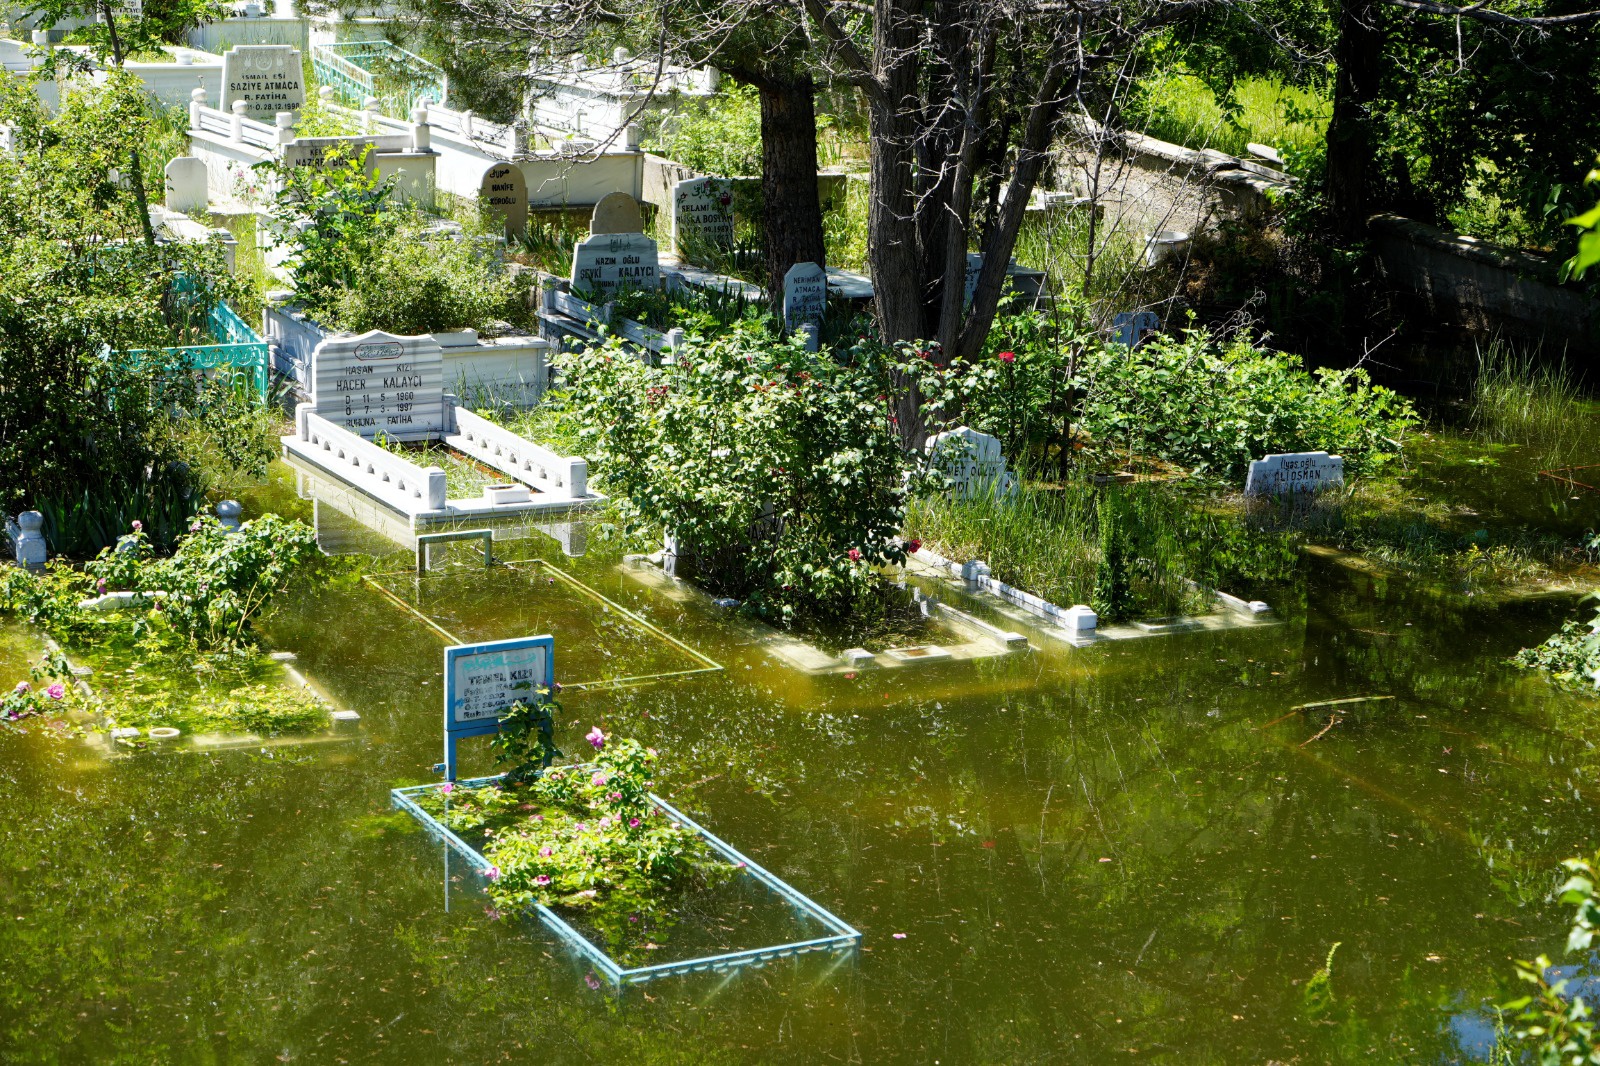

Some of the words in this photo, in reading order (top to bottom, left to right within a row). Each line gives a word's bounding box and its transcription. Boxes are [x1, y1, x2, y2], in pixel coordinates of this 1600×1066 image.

[264, 80, 299, 91] ATMACA
[255, 91, 287, 100] FATİHA
[622, 254, 641, 265] OĞLU
[618, 266, 655, 278] KALAYCI
[345, 365, 373, 375] HASAN
[336, 379, 366, 392] HACER
[396, 391, 414, 401] 1960
[396, 402, 413, 412] 1997
[387, 414, 413, 425] FATİHA
[510, 668, 533, 681] KIZI
